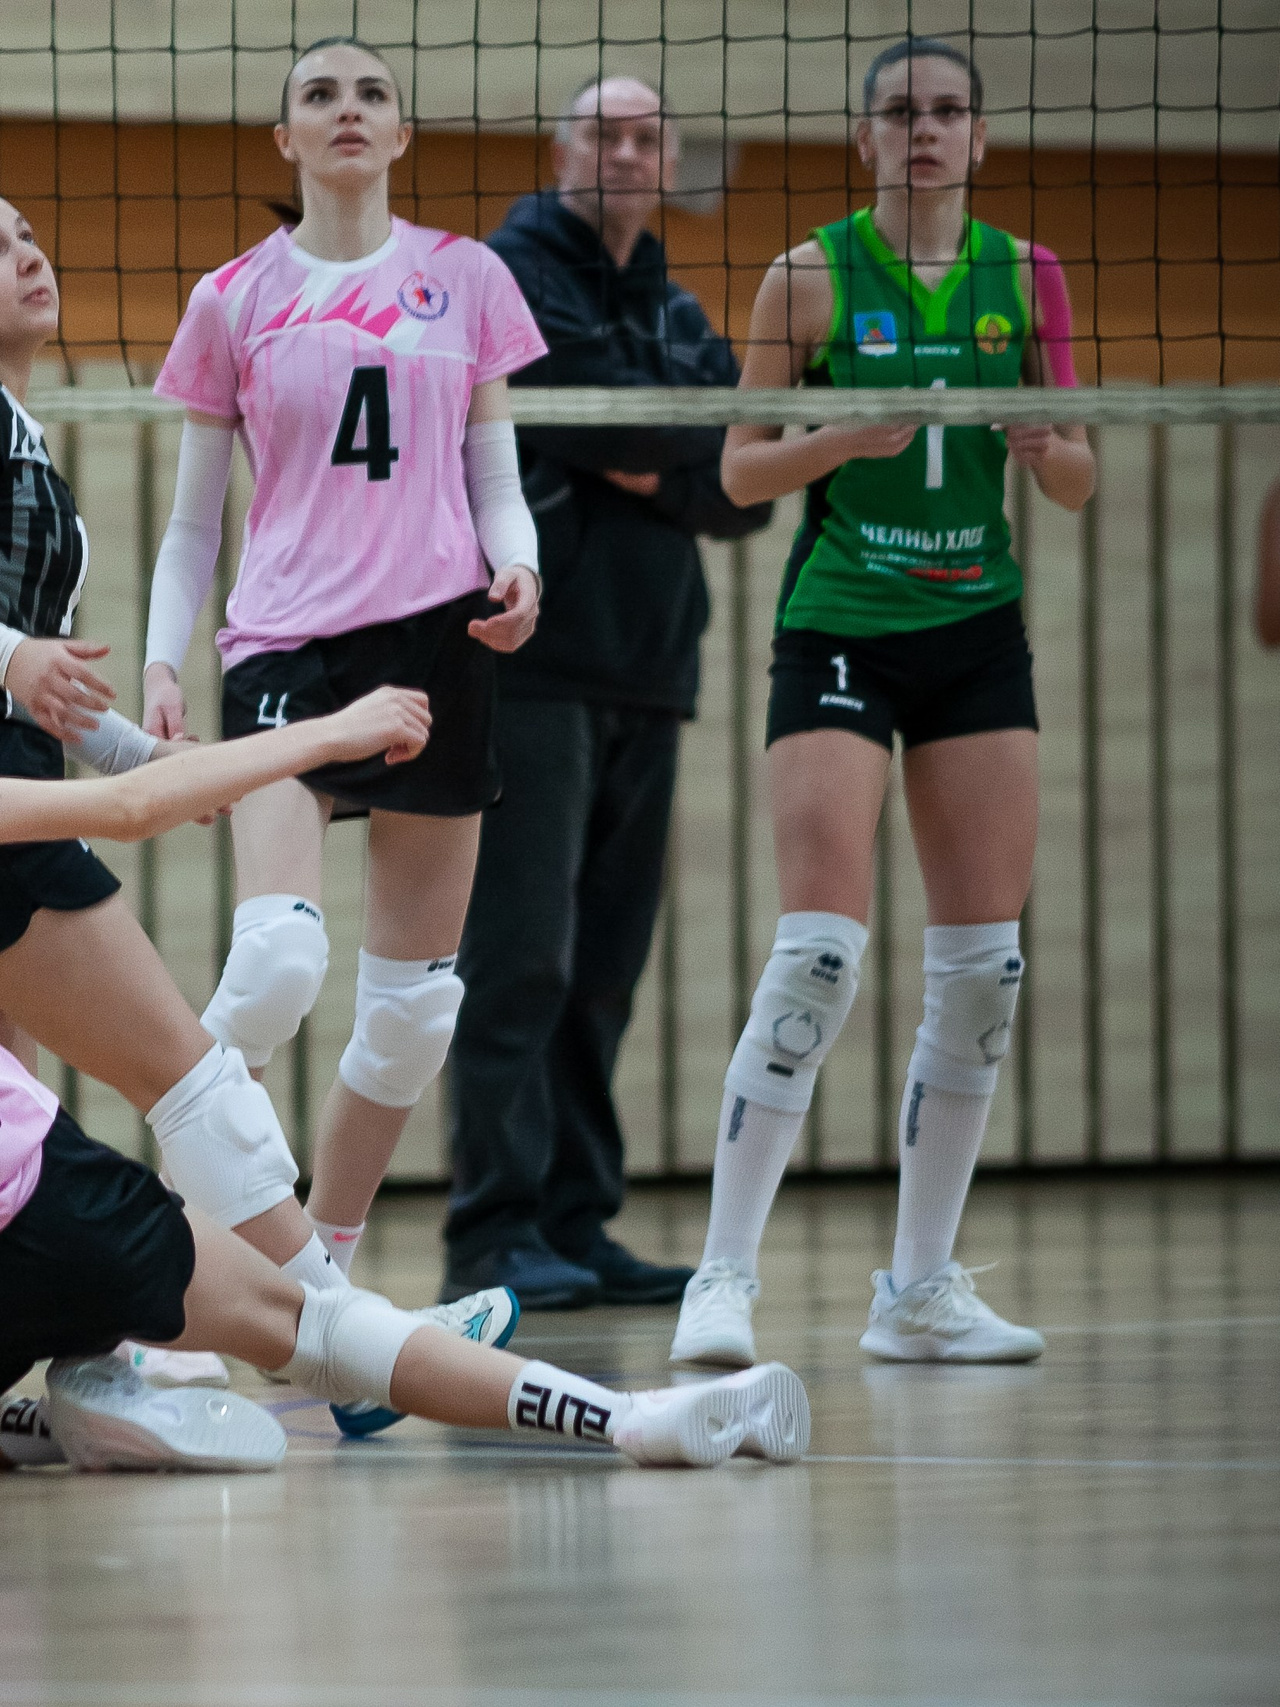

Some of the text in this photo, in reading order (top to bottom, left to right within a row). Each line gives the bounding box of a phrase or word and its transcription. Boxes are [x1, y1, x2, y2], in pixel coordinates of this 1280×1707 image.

[331, 364, 399, 482] 4
[925, 378, 946, 488] 1
[830, 655, 847, 690] 1
[257, 692, 288, 729] 4
